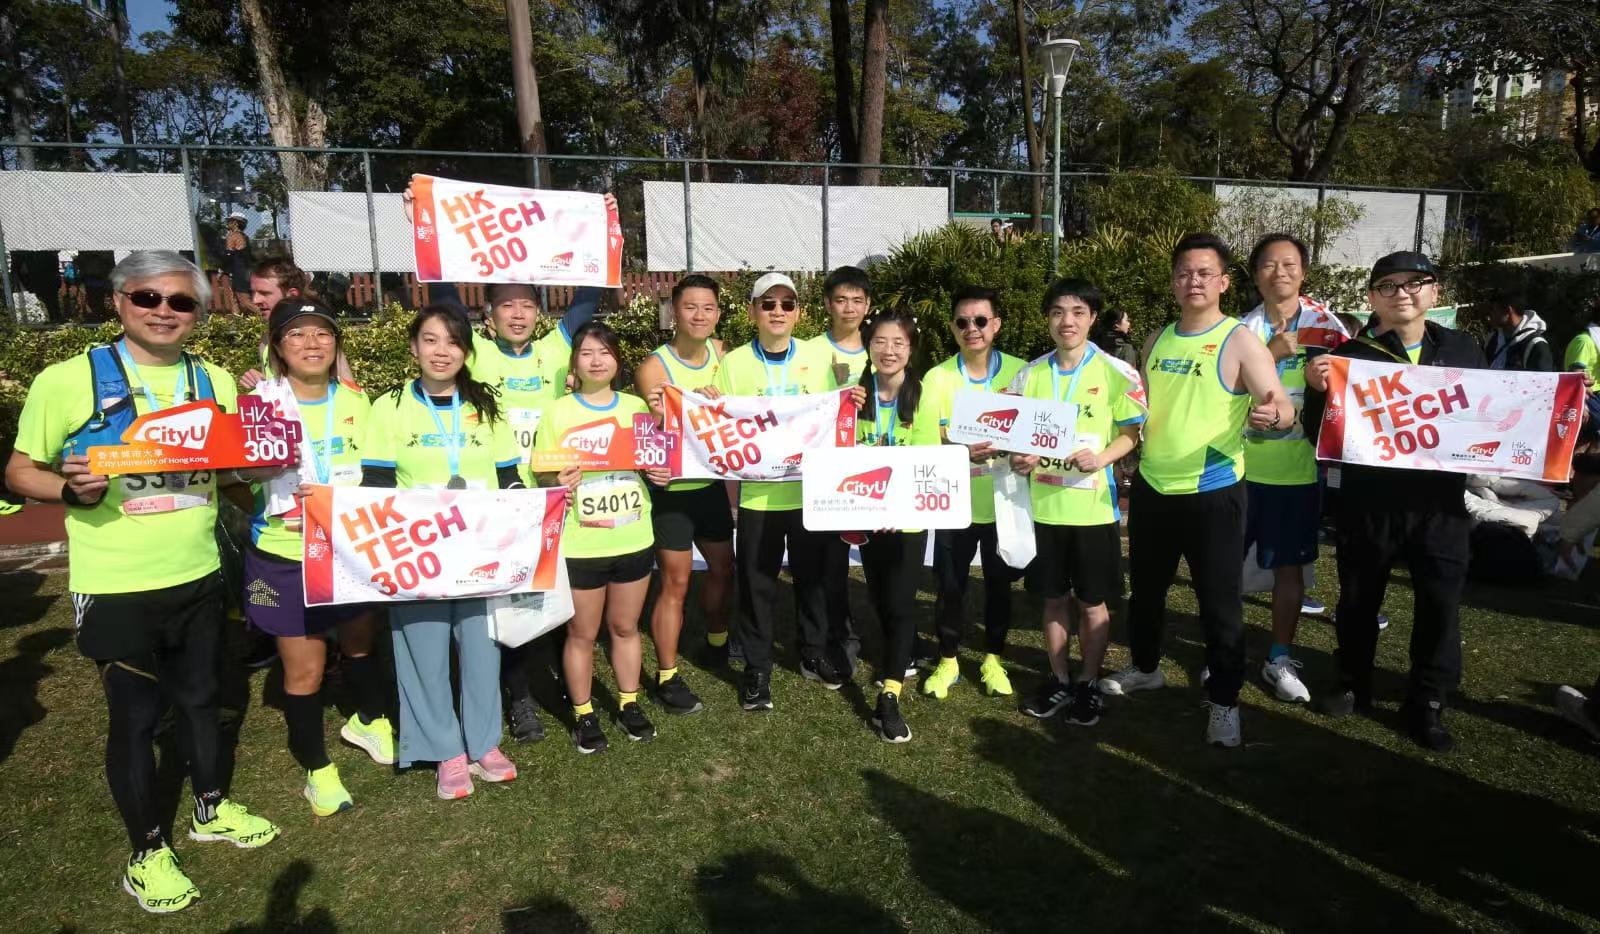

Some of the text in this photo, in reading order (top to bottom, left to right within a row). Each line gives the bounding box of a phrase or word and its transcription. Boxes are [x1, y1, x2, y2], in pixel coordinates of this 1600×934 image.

[440, 189, 496, 224] HK
[455, 200, 546, 249] TECH
[471, 237, 528, 277] 300
[1352, 370, 1413, 408] HK
[241, 406, 270, 422] HK
[687, 402, 736, 432] HK
[1033, 410, 1052, 424] HK
[1361, 383, 1470, 434] TECH
[242, 421, 297, 442] TECH
[634, 421, 655, 436] HK
[696, 409, 779, 454] TECH
[981, 415, 1013, 430] CityU
[144, 425, 206, 446] CityU
[569, 436, 609, 451] CityU
[635, 434, 673, 450] TECH
[1030, 433, 1059, 449] 300
[1372, 423, 1441, 462] 300
[168, 457, 188, 465] Hong
[244, 439, 289, 462] 300
[634, 448, 666, 466] 300
[708, 442, 762, 475] 300
[1470, 446, 1496, 456] CityU
[1511, 455, 1532, 465] 300
[914, 464, 936, 478] HK
[843, 480, 887, 497] CityU
[915, 478, 958, 494] TECH
[582, 490, 642, 516] S4012
[915, 493, 951, 511] 300
[340, 495, 407, 542] HK
[353, 505, 468, 570] TECH
[370, 551, 442, 596] 300
